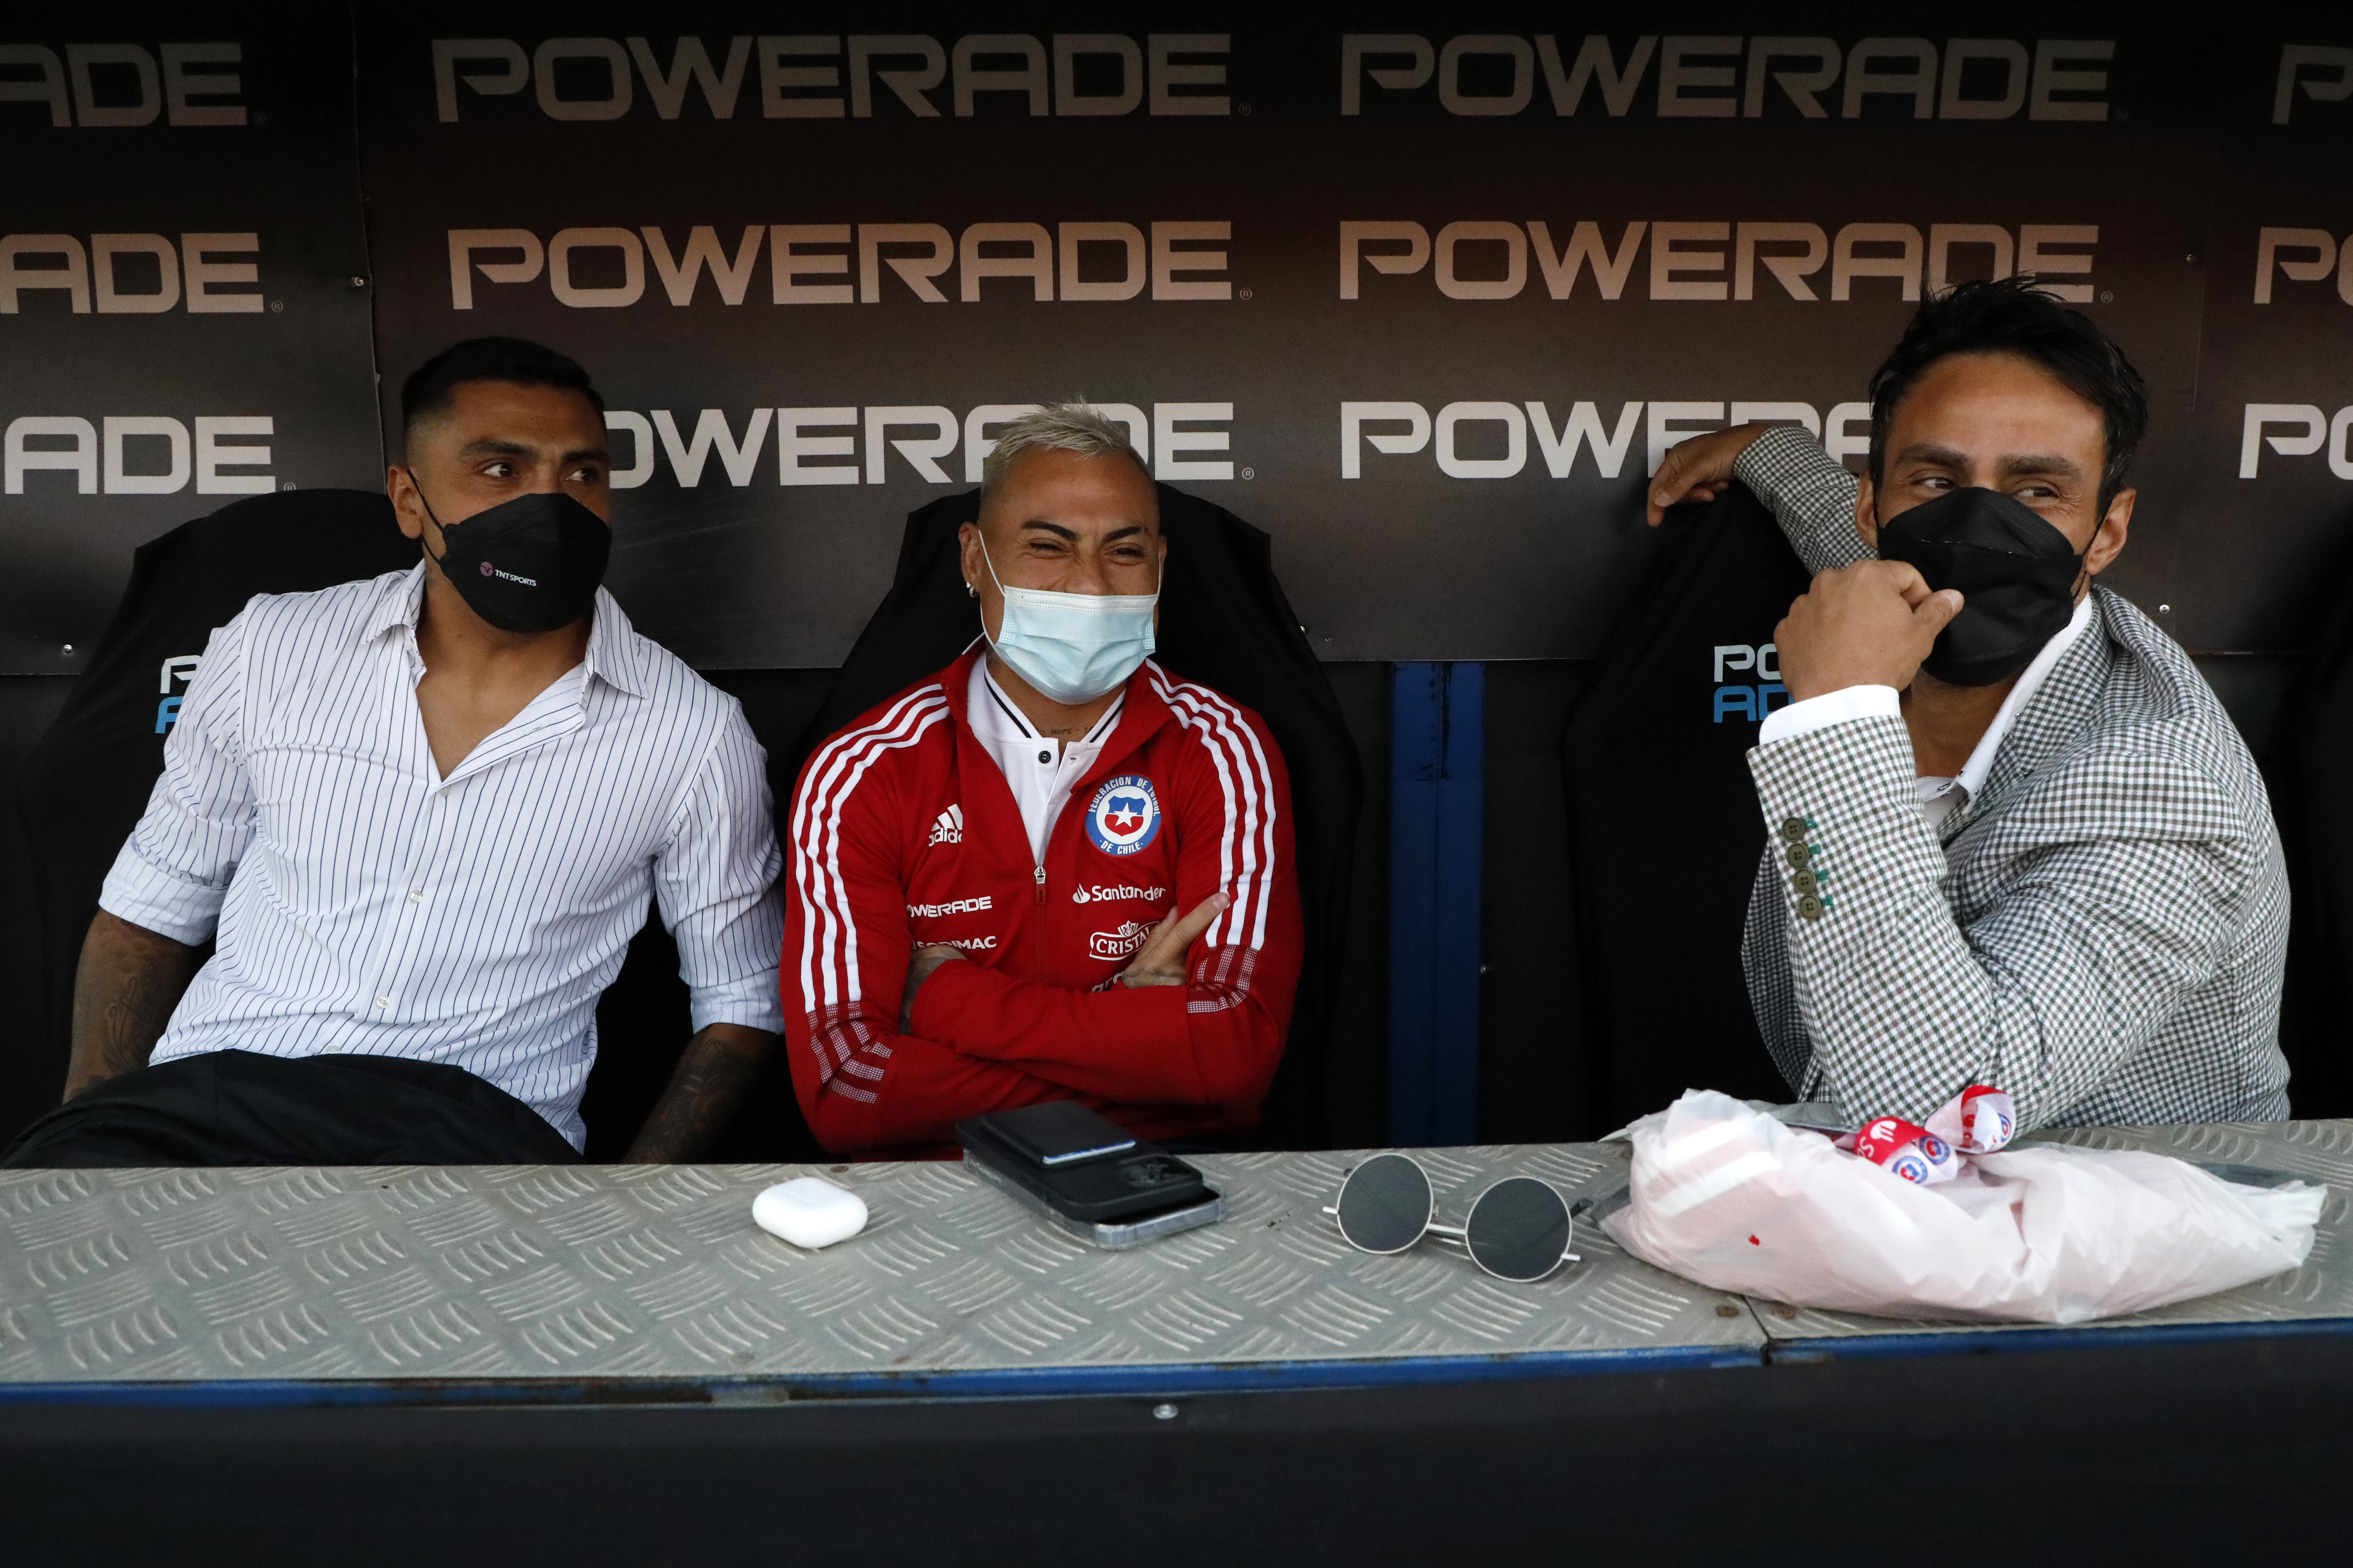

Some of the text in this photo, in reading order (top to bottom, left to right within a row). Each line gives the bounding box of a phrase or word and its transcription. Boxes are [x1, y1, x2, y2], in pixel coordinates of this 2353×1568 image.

[431, 33, 1232, 123] POWERADE
[1341, 34, 2115, 122] POWERADE
[448, 221, 1232, 310] POWERADE
[2254, 227, 2353, 306] P
[4, 416, 276, 494] ADE
[1137, 778, 1148, 789] DE
[1100, 840, 1141, 855] DE CHILE
[1091, 884, 1166, 902] Santander
